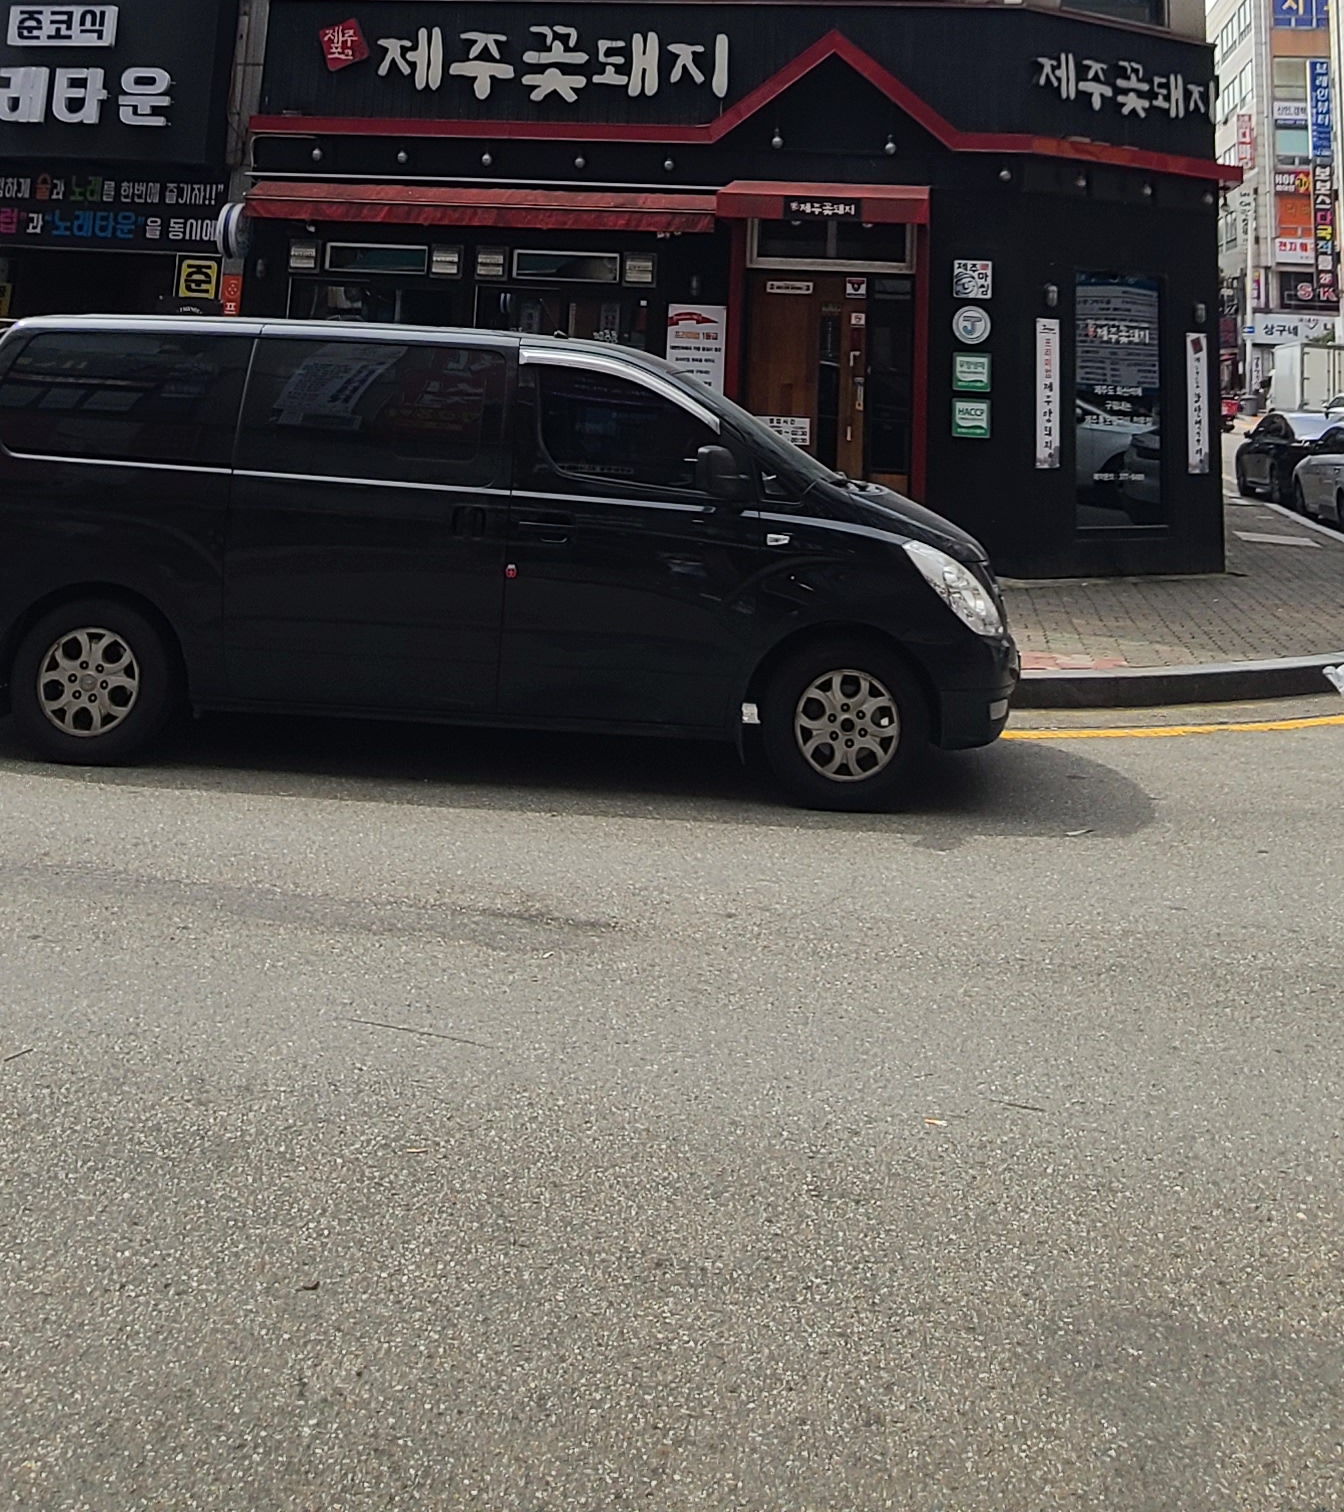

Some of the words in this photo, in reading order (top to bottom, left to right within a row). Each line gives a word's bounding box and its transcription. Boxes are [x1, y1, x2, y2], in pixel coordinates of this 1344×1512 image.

[16, 9, 106, 41] 준코식
[376, 25, 729, 103] 제주꽃돼지
[1036, 53, 1216, 124] 제주꽃돼지
[121, 181, 160, 203] 한번에
[799, 202, 855, 216] 제주꽃돼지
[168, 218, 217, 242] 동시에
[183, 262, 216, 294] 준
[958, 407, 985, 417] HACCP
